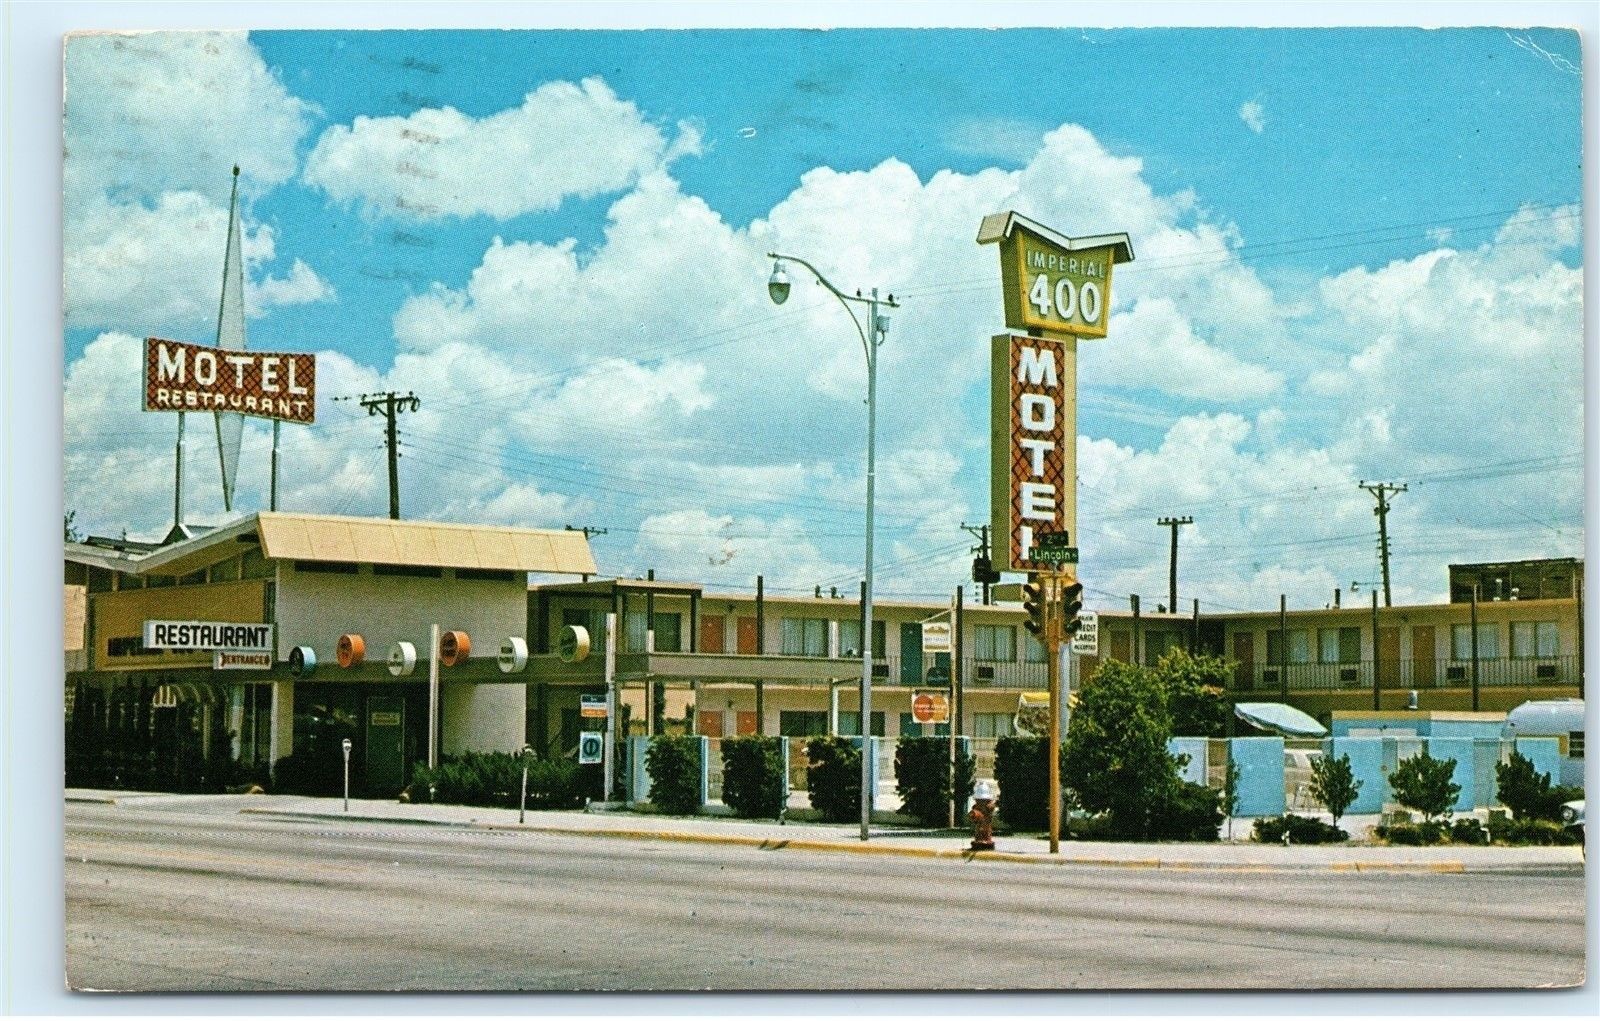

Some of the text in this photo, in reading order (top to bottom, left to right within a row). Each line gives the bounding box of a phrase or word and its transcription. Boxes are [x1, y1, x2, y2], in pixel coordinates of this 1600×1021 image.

[1027, 250, 1105, 278] IMPERIAL
[1029, 273, 1101, 323] 400
[157, 343, 308, 395] MOTEL
[157, 388, 308, 417] RESTAURANT
[1034, 549, 1071, 561] Lincoln
[154, 624, 270, 648] RESTAURANT
